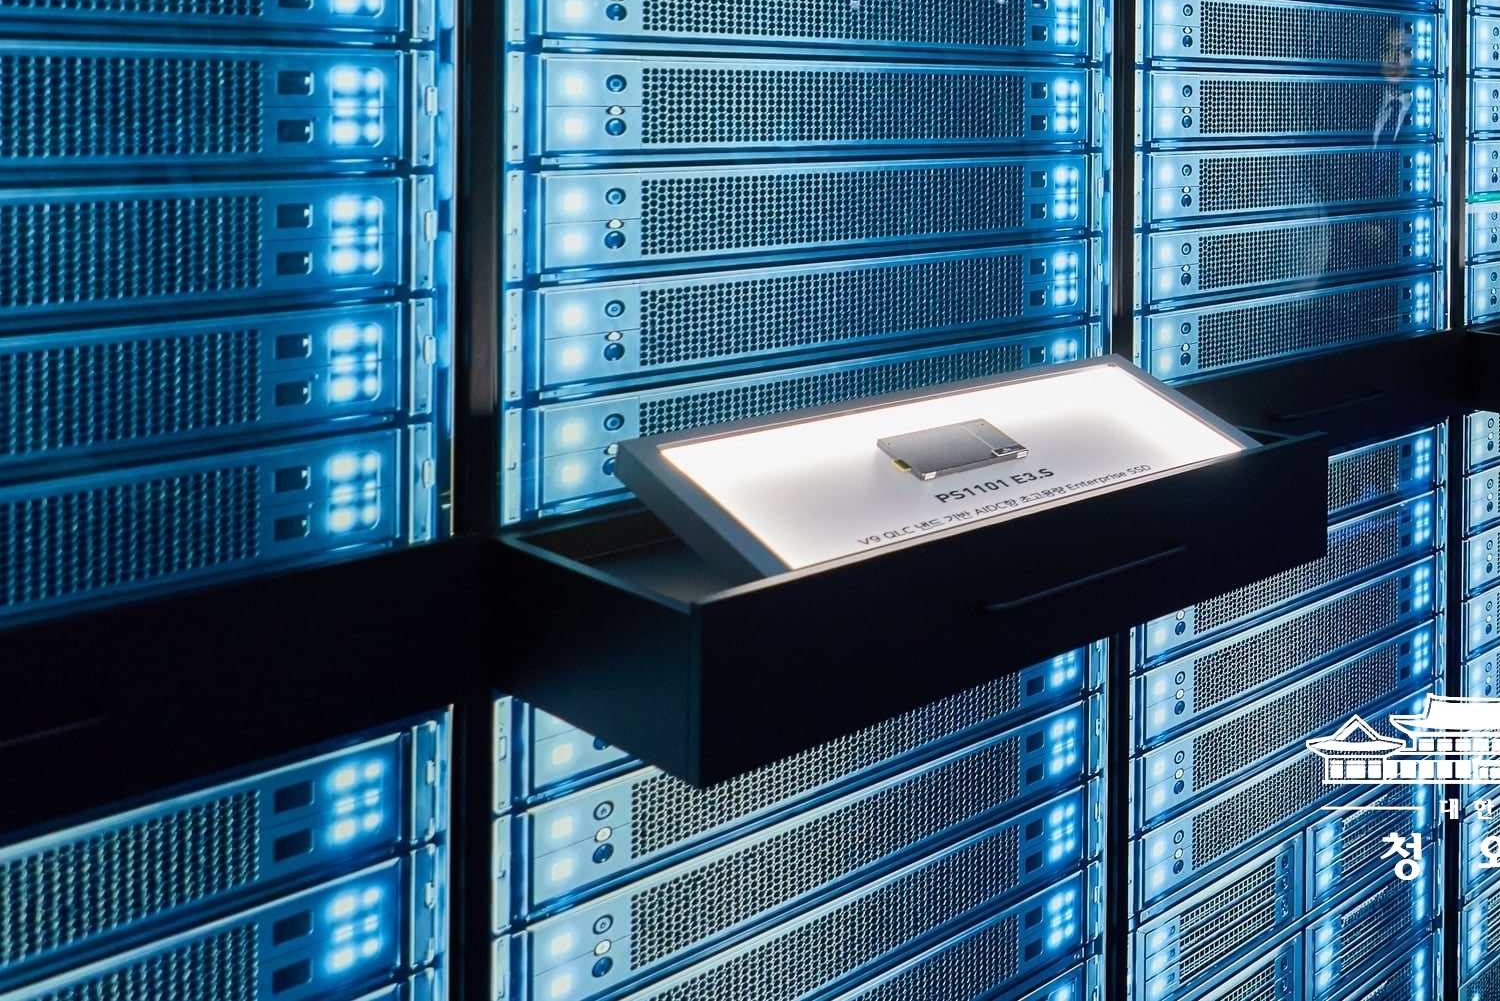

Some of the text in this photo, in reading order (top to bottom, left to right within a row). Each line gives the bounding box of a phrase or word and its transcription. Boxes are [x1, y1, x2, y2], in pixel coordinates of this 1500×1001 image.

[858, 535, 881, 545] V9
[883, 526, 915, 539] QLC
[948, 510, 972, 522] 기반
[1066, 471, 1127, 491] Enterprise
[1126, 464, 1151, 475] SSD
[935, 468, 1054, 503] PS1101 E3.S
